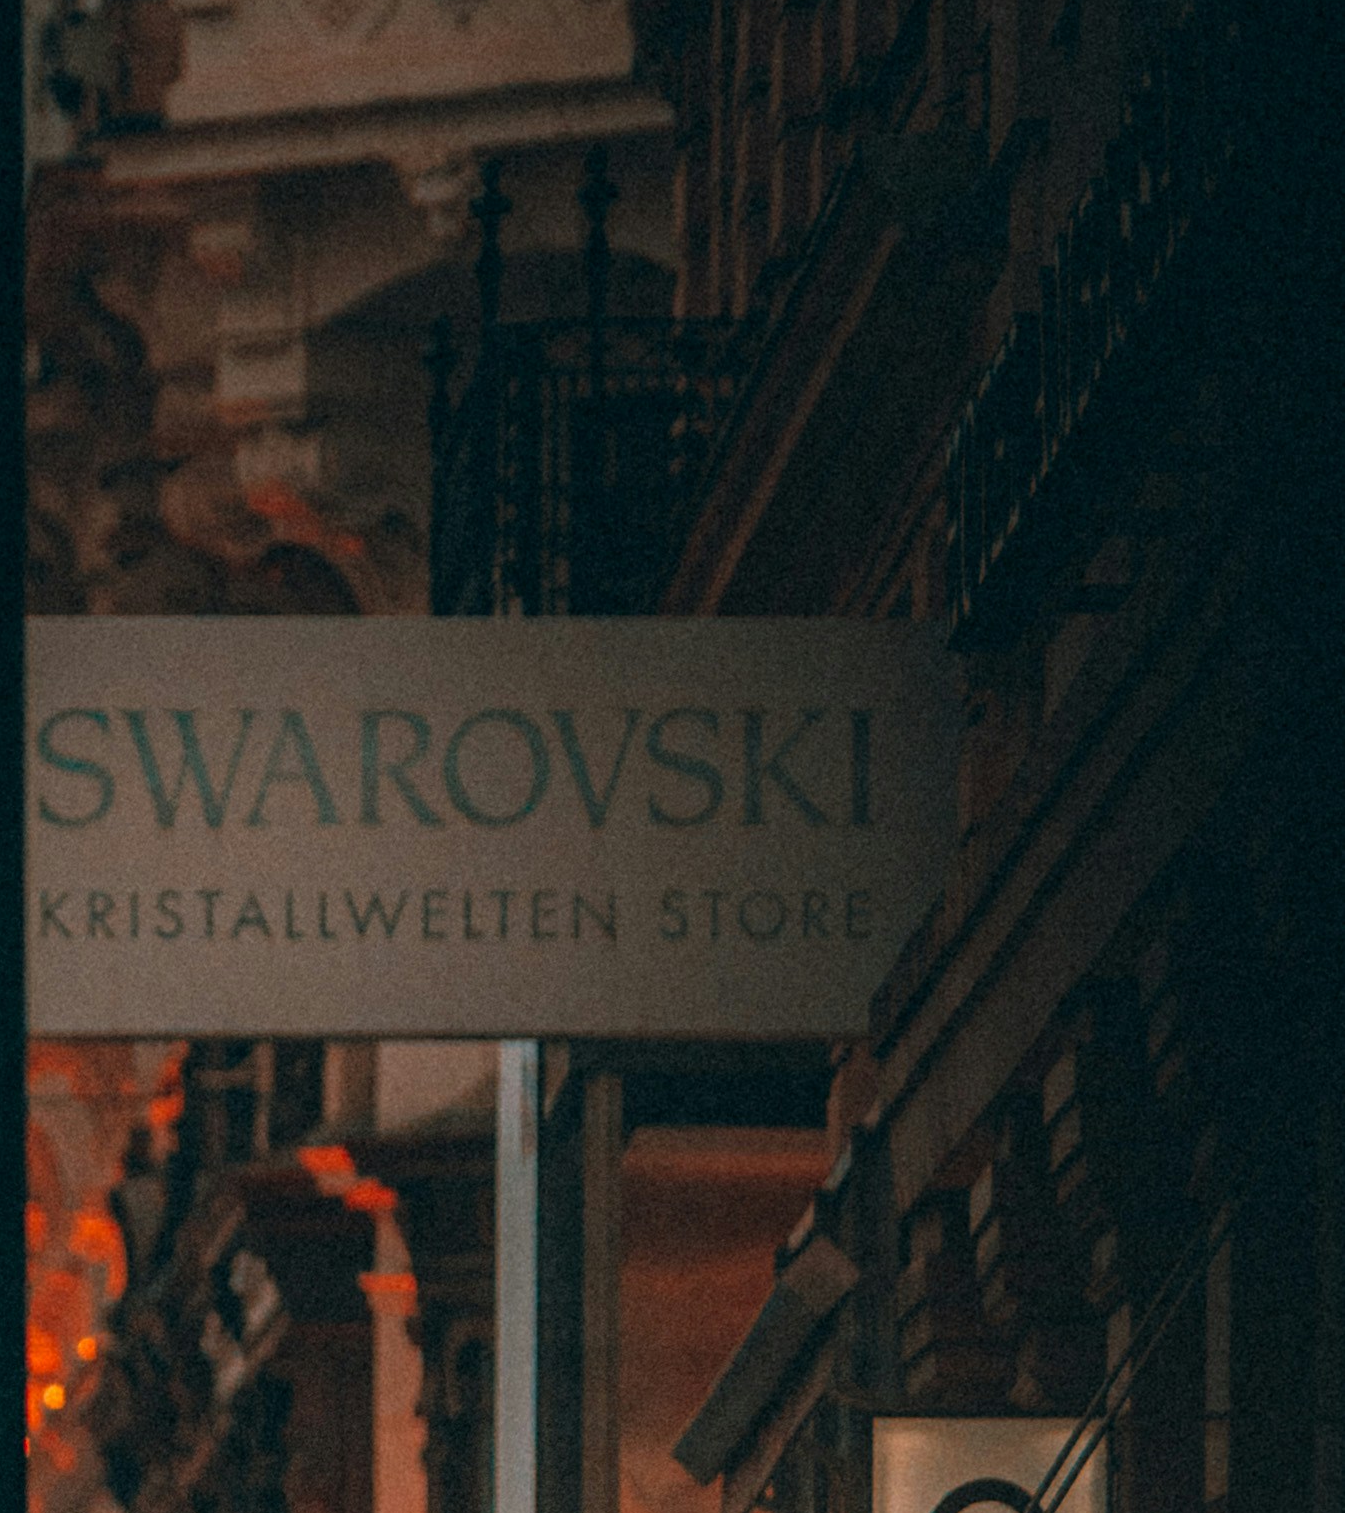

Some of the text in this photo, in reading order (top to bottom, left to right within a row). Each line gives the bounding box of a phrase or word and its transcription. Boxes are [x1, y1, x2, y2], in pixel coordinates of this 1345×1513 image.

[36, 707, 874, 831] SWAROVSKI
[38, 889, 872, 943] KRISTALLWELTEN STORE
